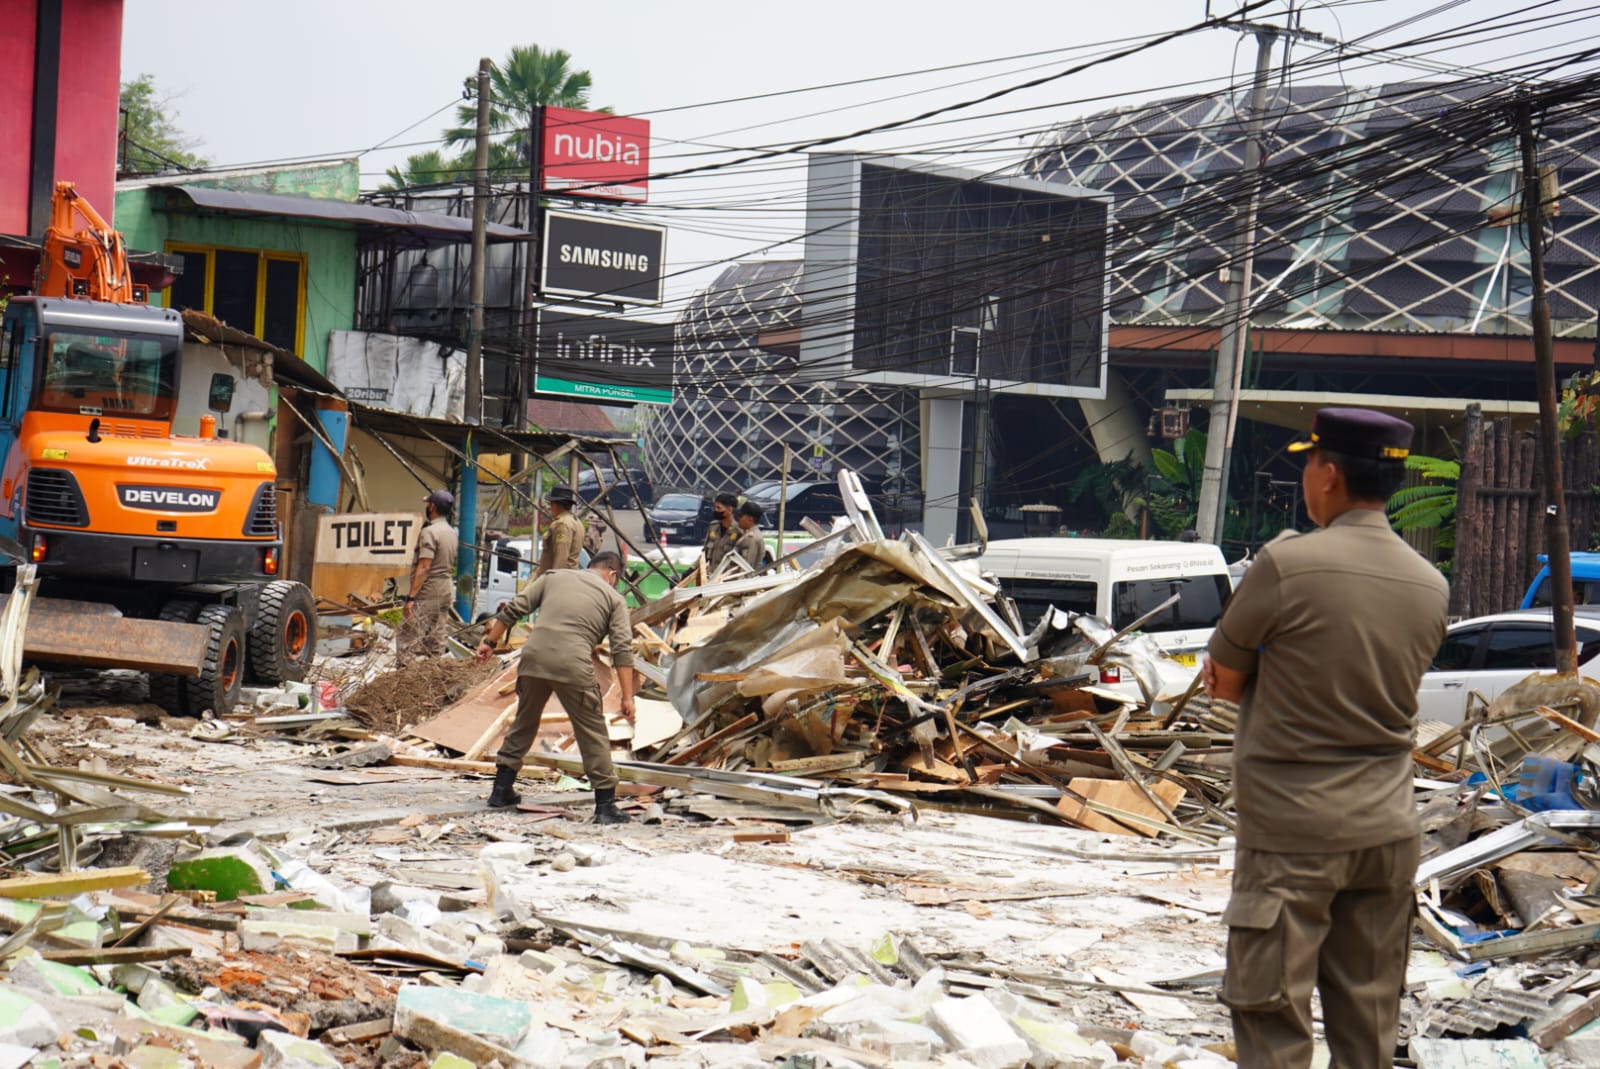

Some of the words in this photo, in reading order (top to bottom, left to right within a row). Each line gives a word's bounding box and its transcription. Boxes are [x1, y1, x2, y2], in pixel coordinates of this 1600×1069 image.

[554, 133, 640, 166] nubia
[560, 244, 649, 272] SAMSUNG
[574, 383, 601, 394] MITRA
[602, 387, 636, 398] PONSEL
[125, 489, 214, 507] DEVELON
[331, 521, 413, 549] TOILET
